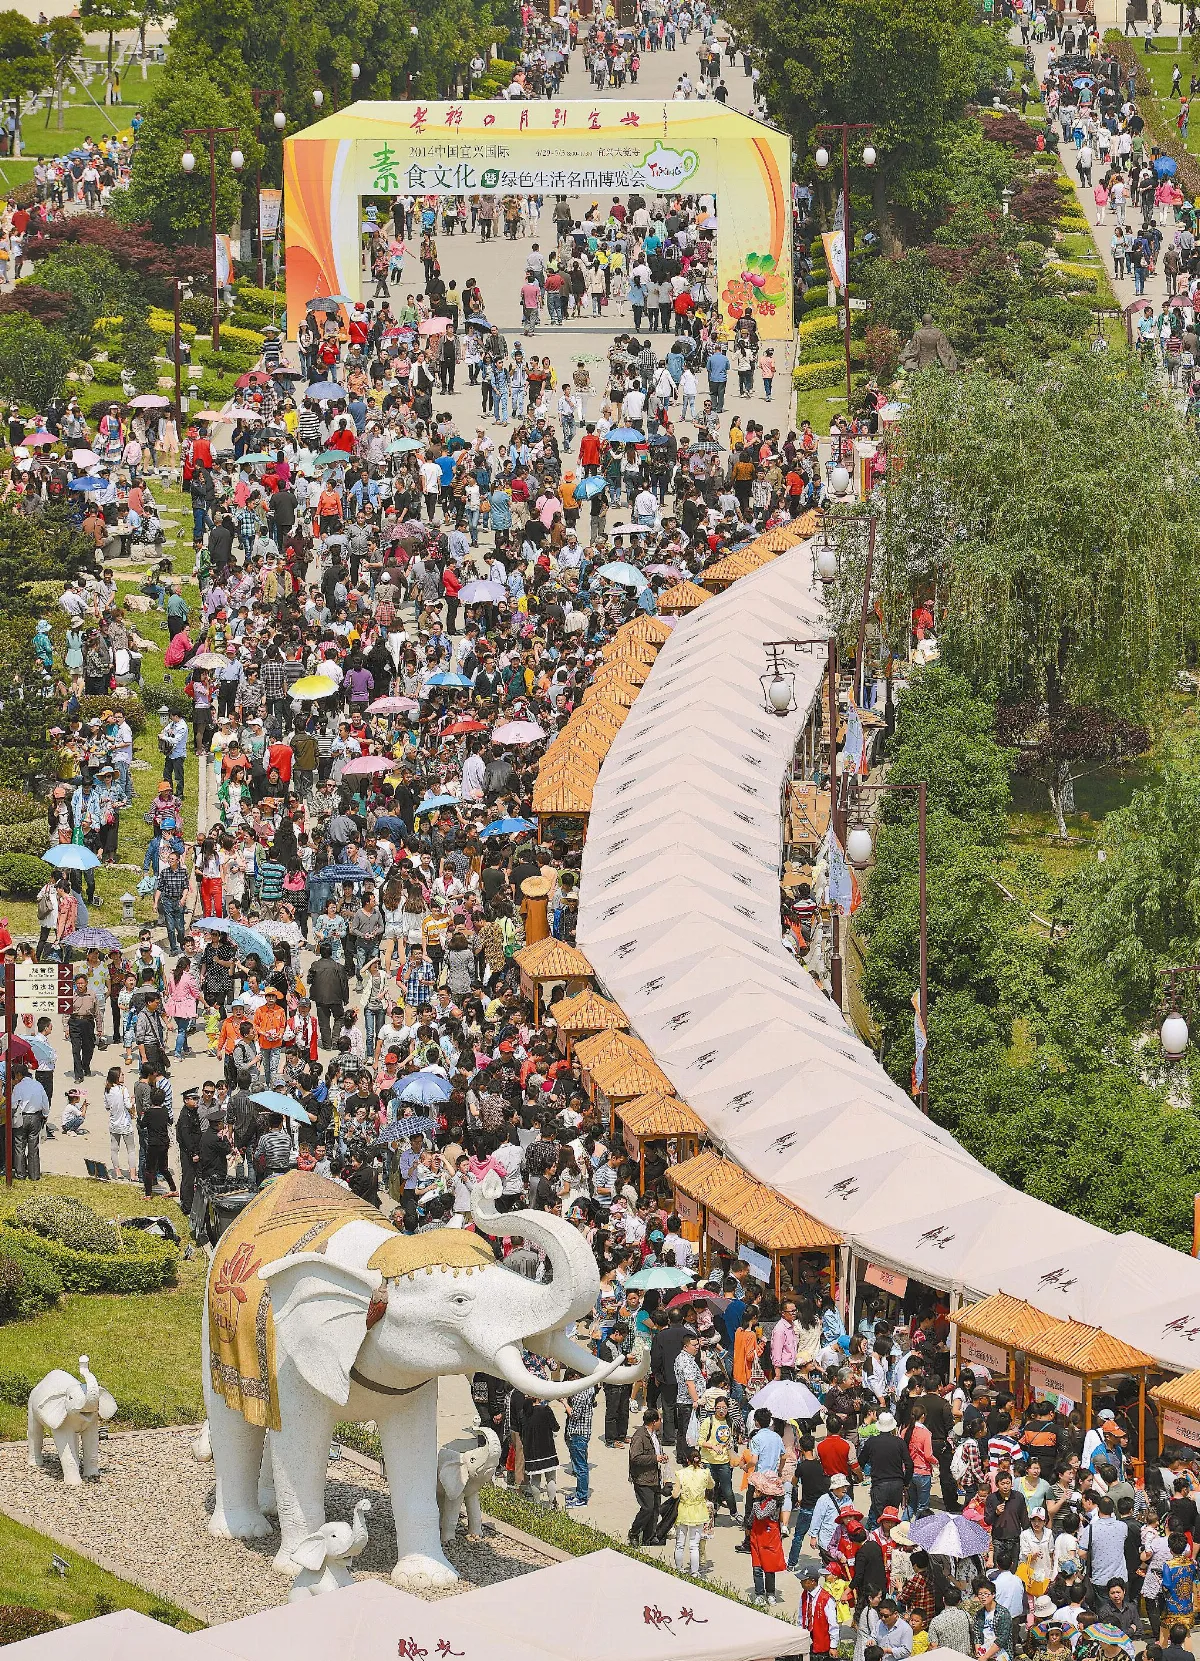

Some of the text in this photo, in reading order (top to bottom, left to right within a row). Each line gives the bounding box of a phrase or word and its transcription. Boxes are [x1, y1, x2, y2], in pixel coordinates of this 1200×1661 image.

[369, 141, 400, 193] 素
[404, 163, 477, 189] 食文化
[501, 169, 647, 188] 绿色生活名品博览会
[408, 144, 510, 159] 2014中国宜兴国际
